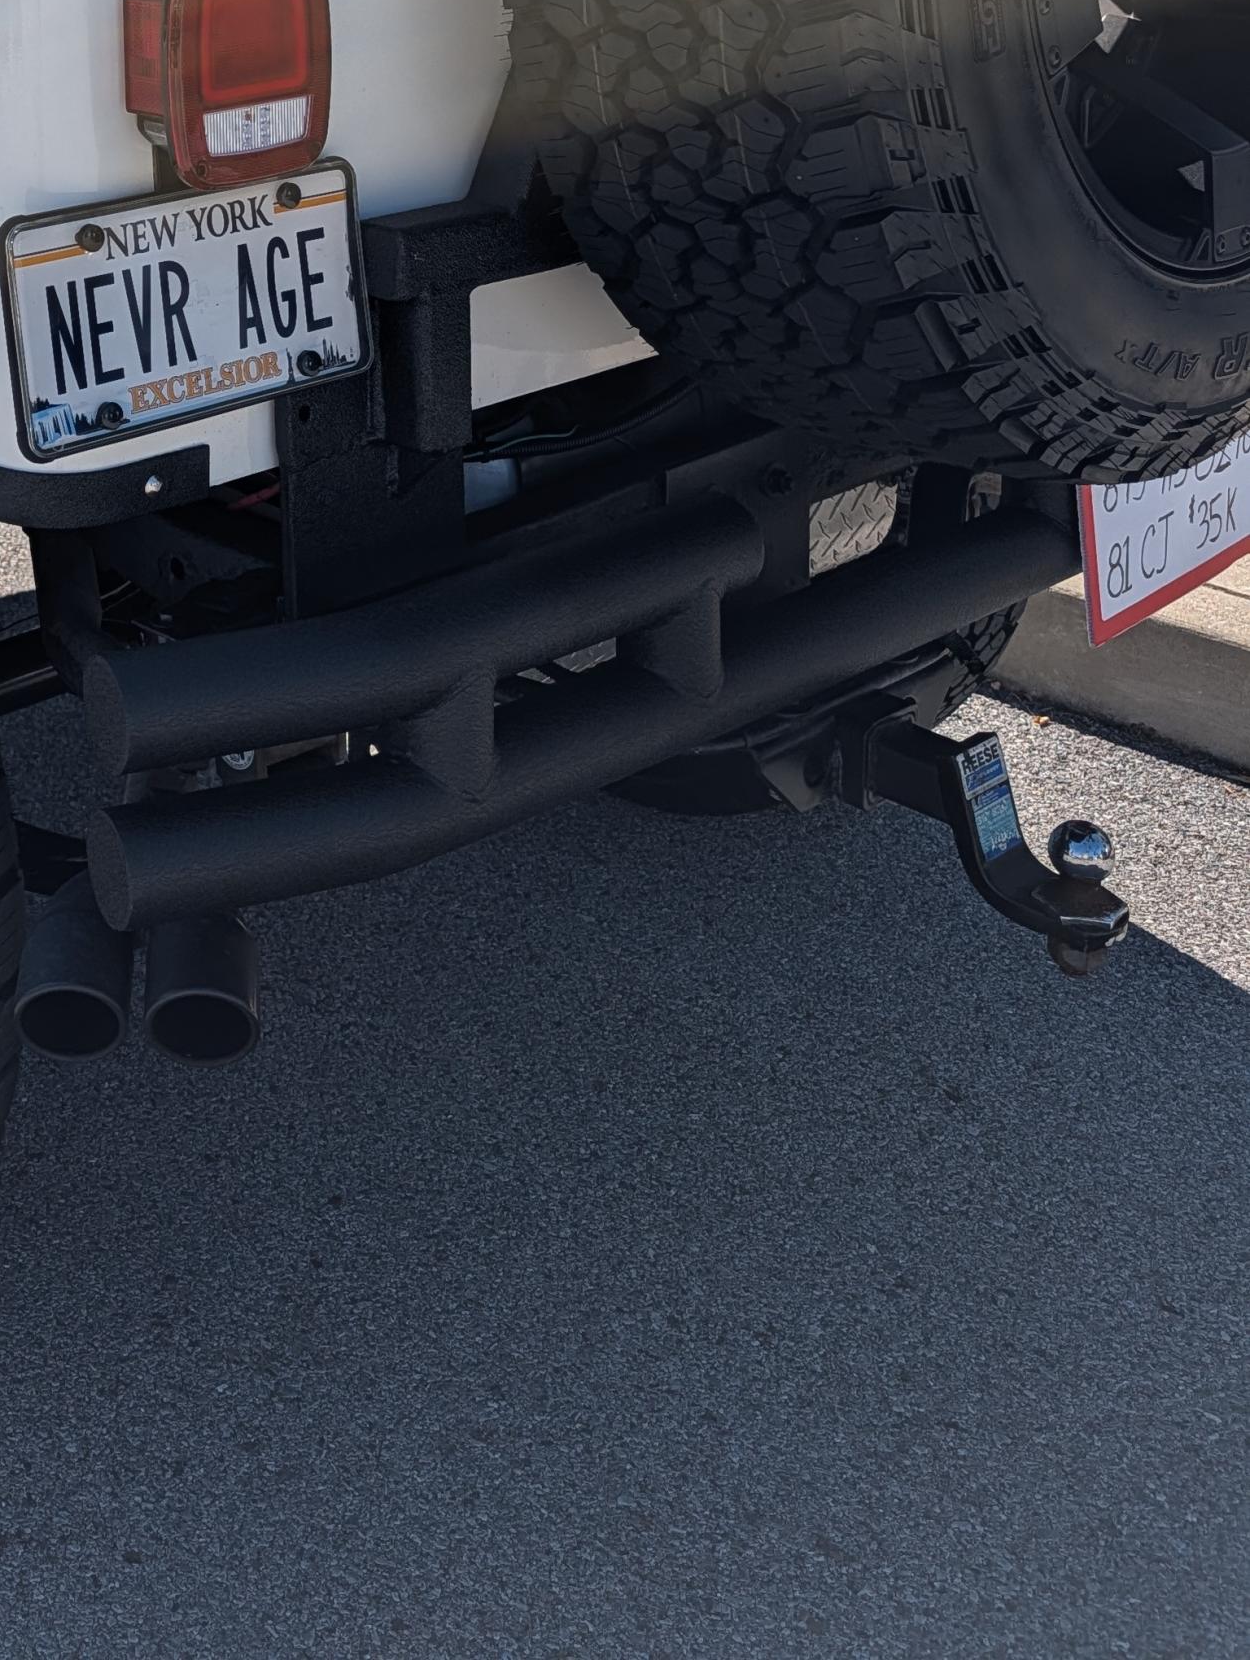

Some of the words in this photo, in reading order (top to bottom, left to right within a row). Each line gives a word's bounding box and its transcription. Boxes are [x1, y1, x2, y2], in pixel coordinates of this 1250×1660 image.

[103, 213, 179, 262] NEW
[191, 194, 275, 241] YORK
[45, 260, 199, 396] NEVR
[237, 226, 335, 351] AGE
[128, 351, 282, 415] EXCELSIOR
[1106, 535, 1133, 599] 81
[1140, 510, 1175, 580] CJ
[961, 742, 1001, 776] REESE
